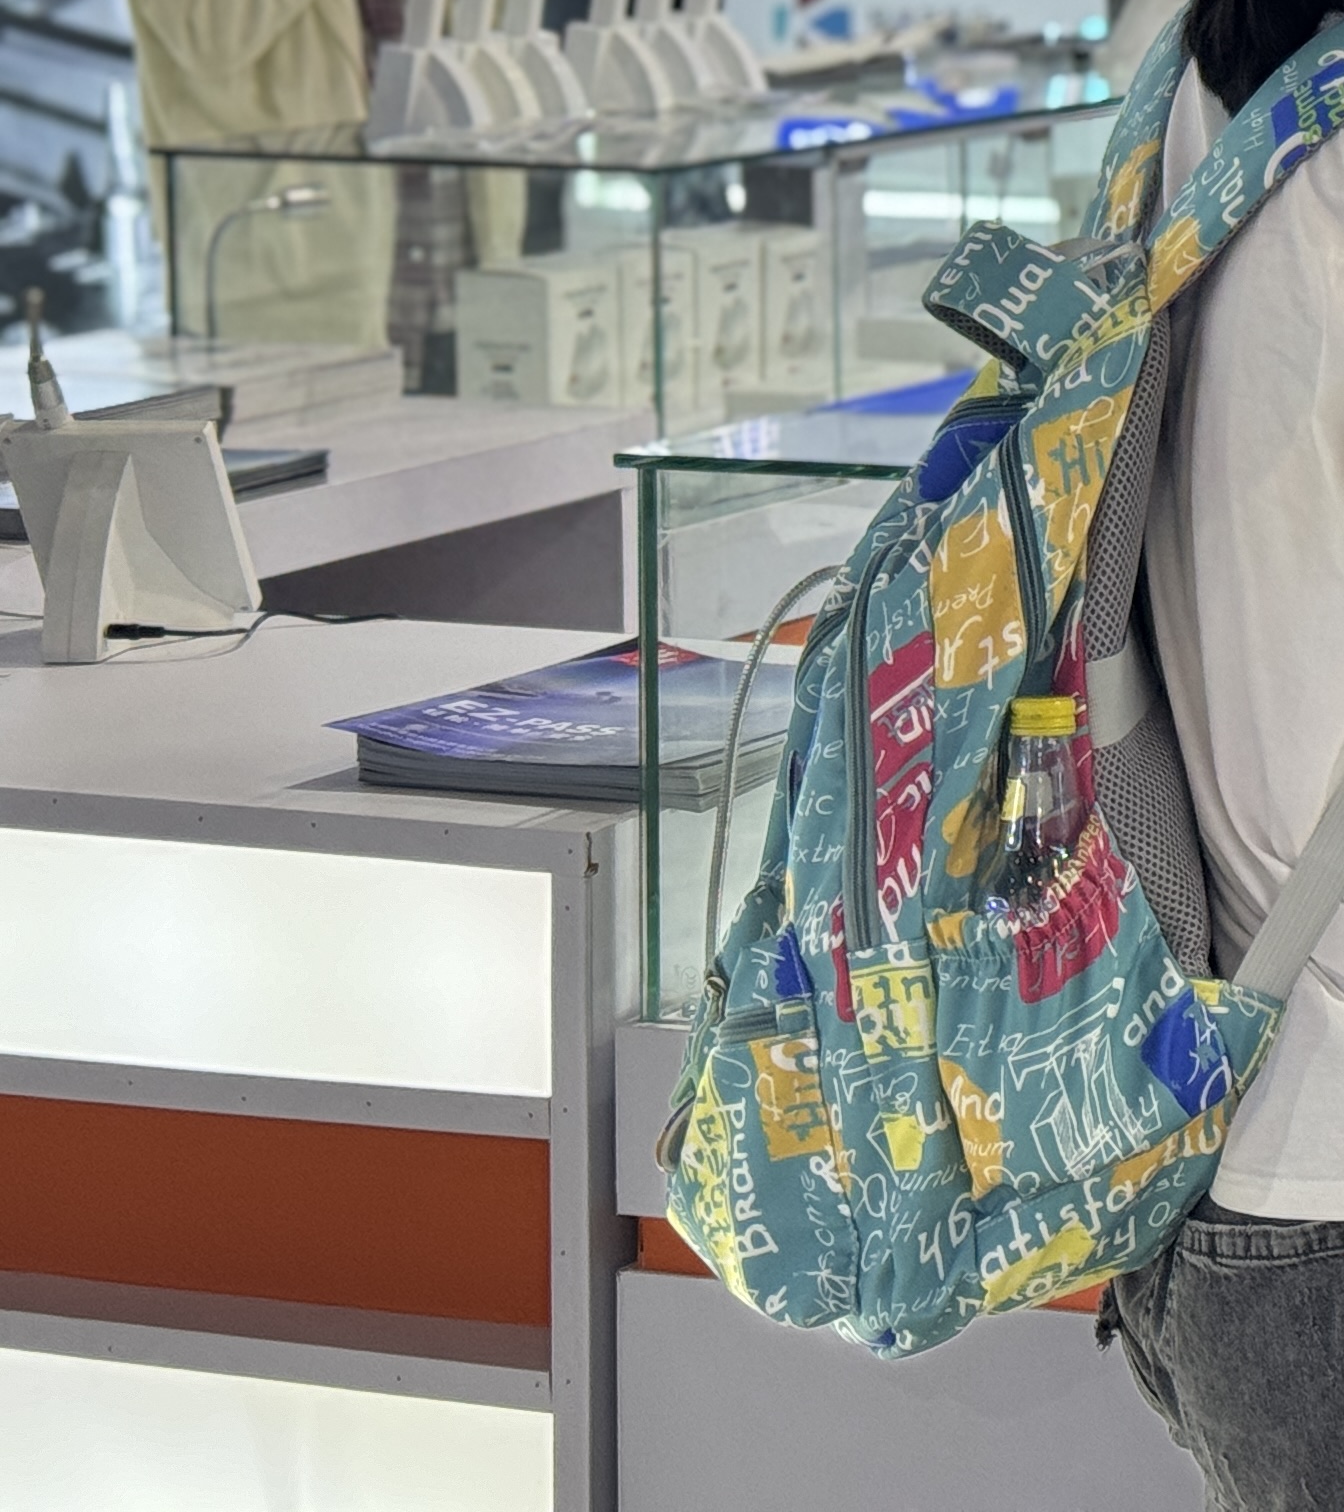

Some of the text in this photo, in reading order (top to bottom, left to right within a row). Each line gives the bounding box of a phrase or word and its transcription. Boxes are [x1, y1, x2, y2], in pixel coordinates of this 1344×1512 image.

[972, 242, 1066, 339] Qual
[439, 698, 626, 737] EZ-PASS
[1124, 957, 1185, 1046] and
